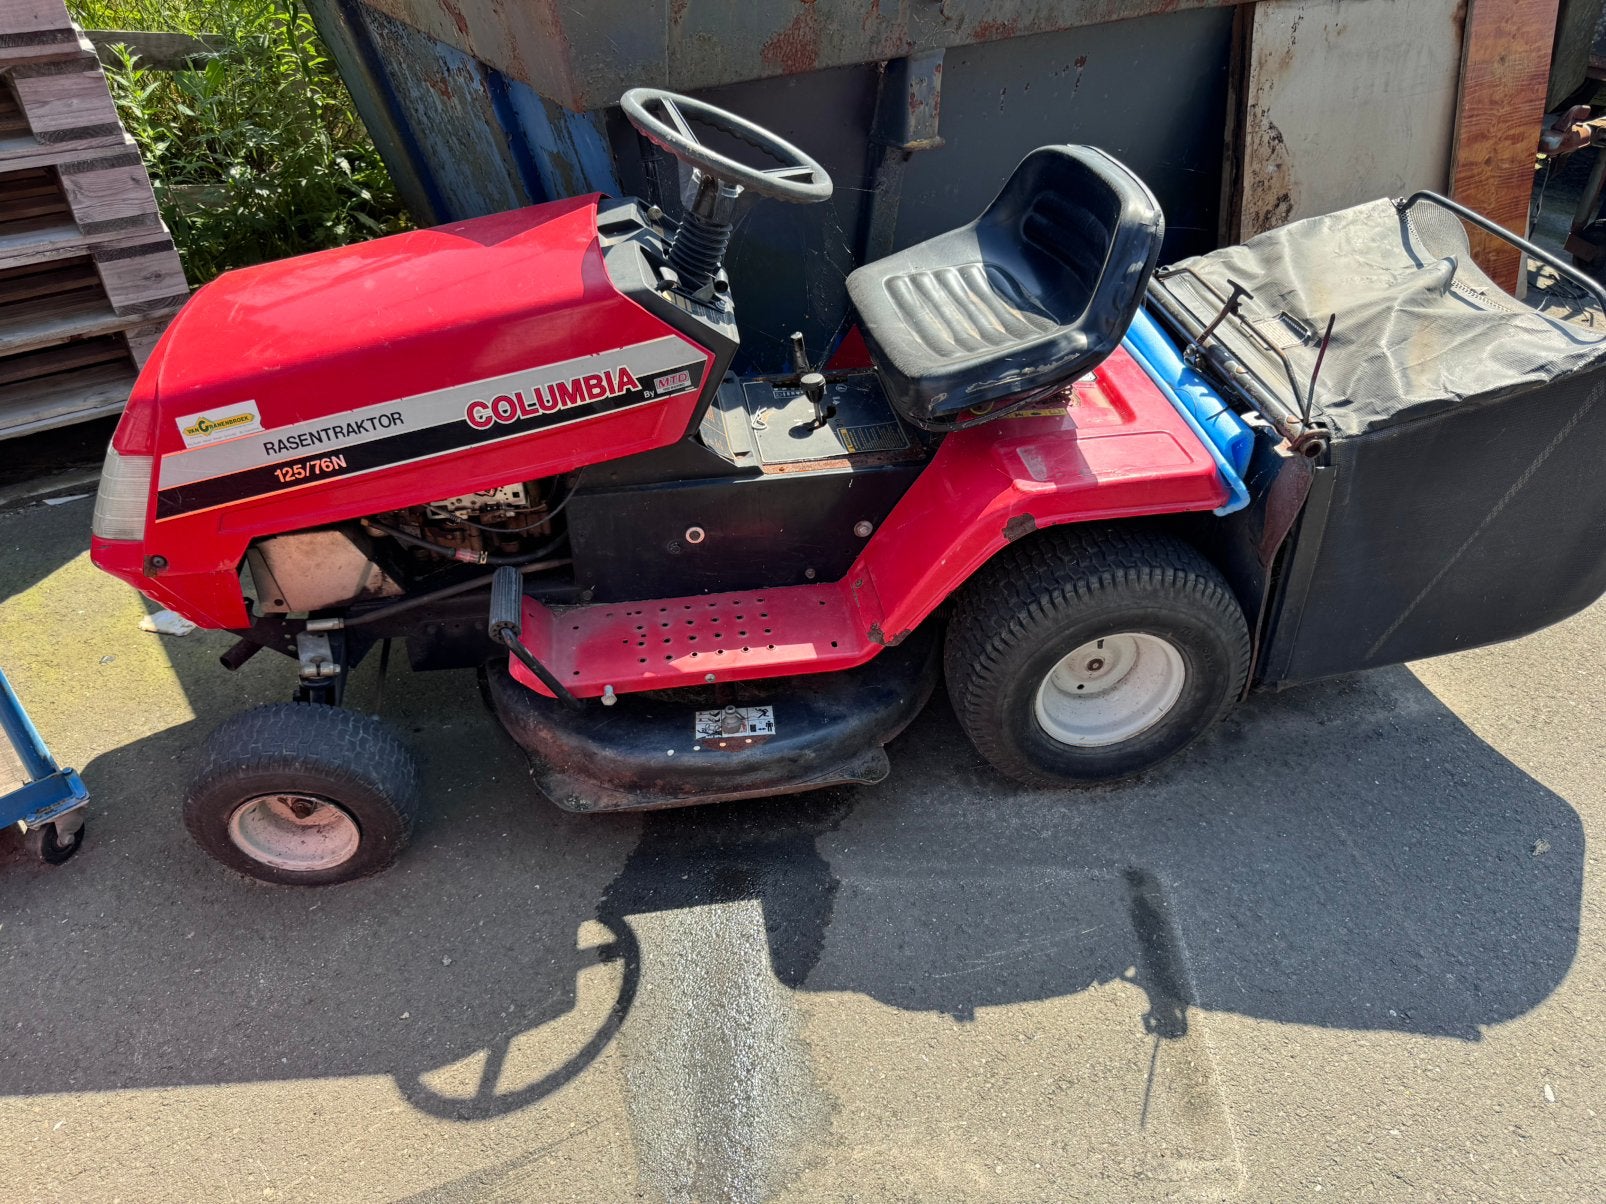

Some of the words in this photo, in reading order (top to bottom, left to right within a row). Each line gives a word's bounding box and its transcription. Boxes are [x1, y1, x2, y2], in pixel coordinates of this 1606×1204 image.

[643, 390, 655, 399] By
[658, 372, 688, 389] MTD
[466, 365, 641, 430] COLUMBIA
[263, 411, 404, 456] RASENTRAKTOR
[274, 454, 347, 483] 125/76N
